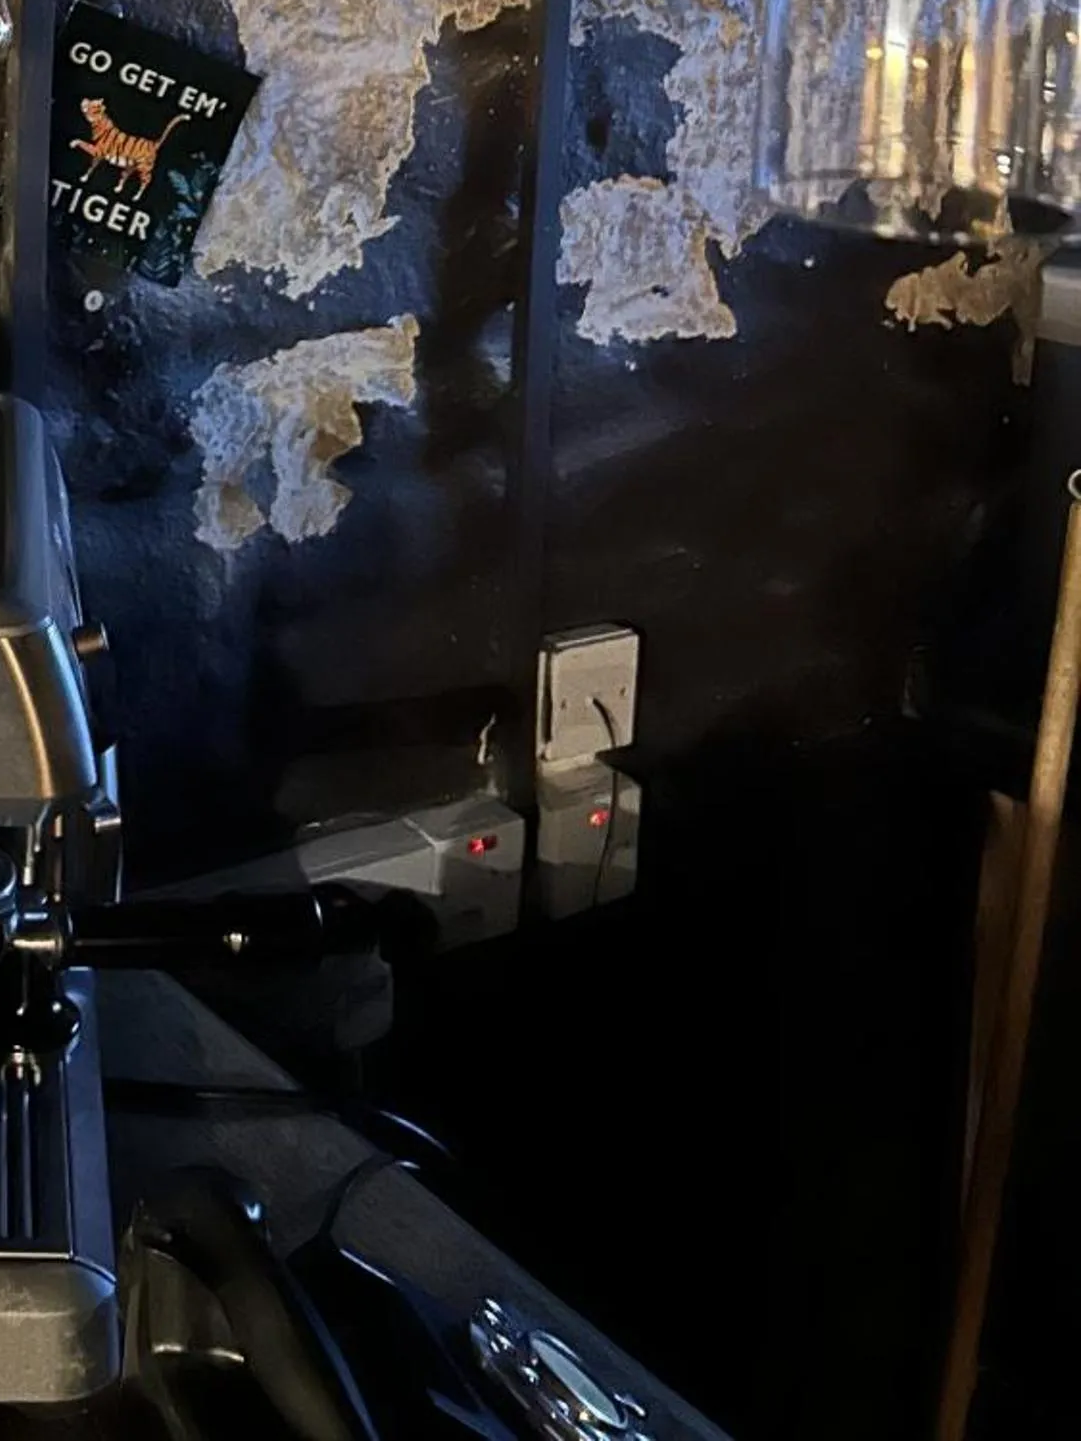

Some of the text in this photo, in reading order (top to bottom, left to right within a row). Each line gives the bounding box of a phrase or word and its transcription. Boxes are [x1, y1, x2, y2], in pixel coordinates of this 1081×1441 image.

[70, 41, 112, 73] GO
[120, 62, 176, 99] GET
[51, 179, 151, 241] TIGER
